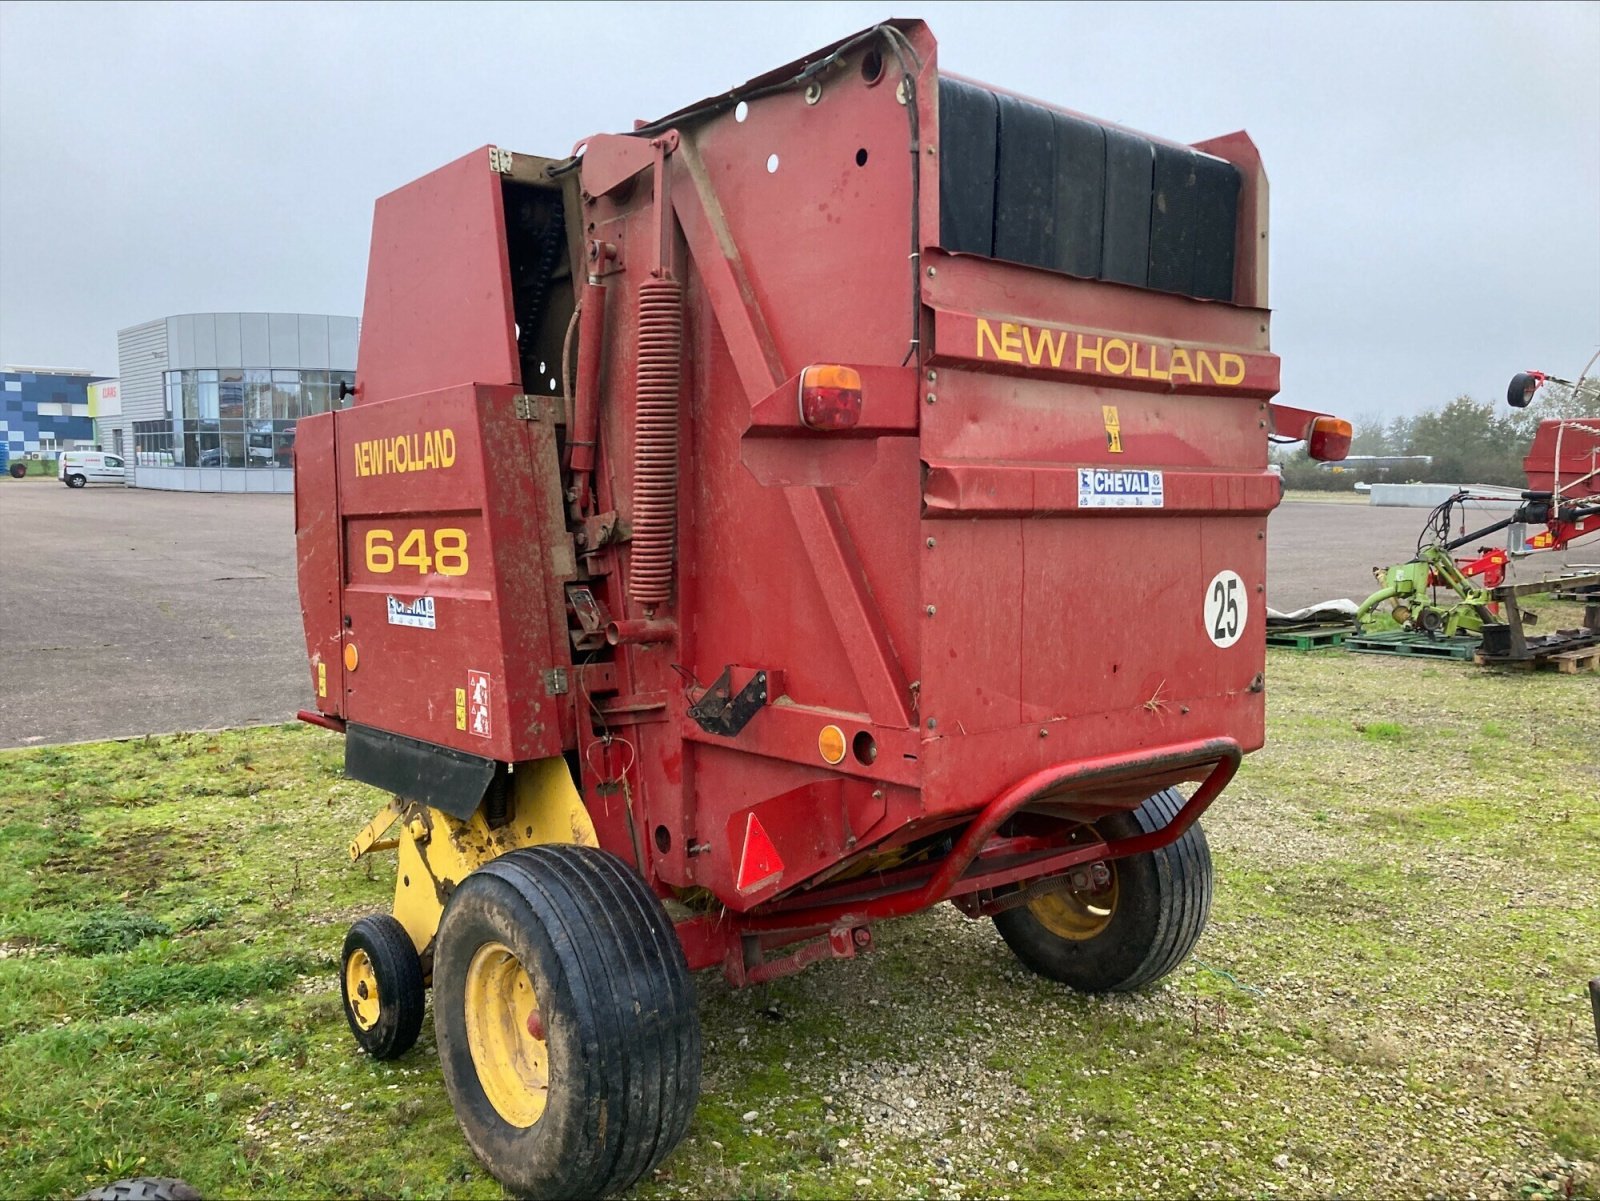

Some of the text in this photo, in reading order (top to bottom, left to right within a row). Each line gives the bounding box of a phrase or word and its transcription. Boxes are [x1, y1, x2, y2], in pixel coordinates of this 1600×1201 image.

[977, 318, 1246, 386] NEW HOLLAND
[354, 428, 456, 477] NEW HOLLAND
[1094, 472, 1149, 493] CHEVAL
[365, 528, 469, 576] 648
[1214, 579, 1238, 639] 25
